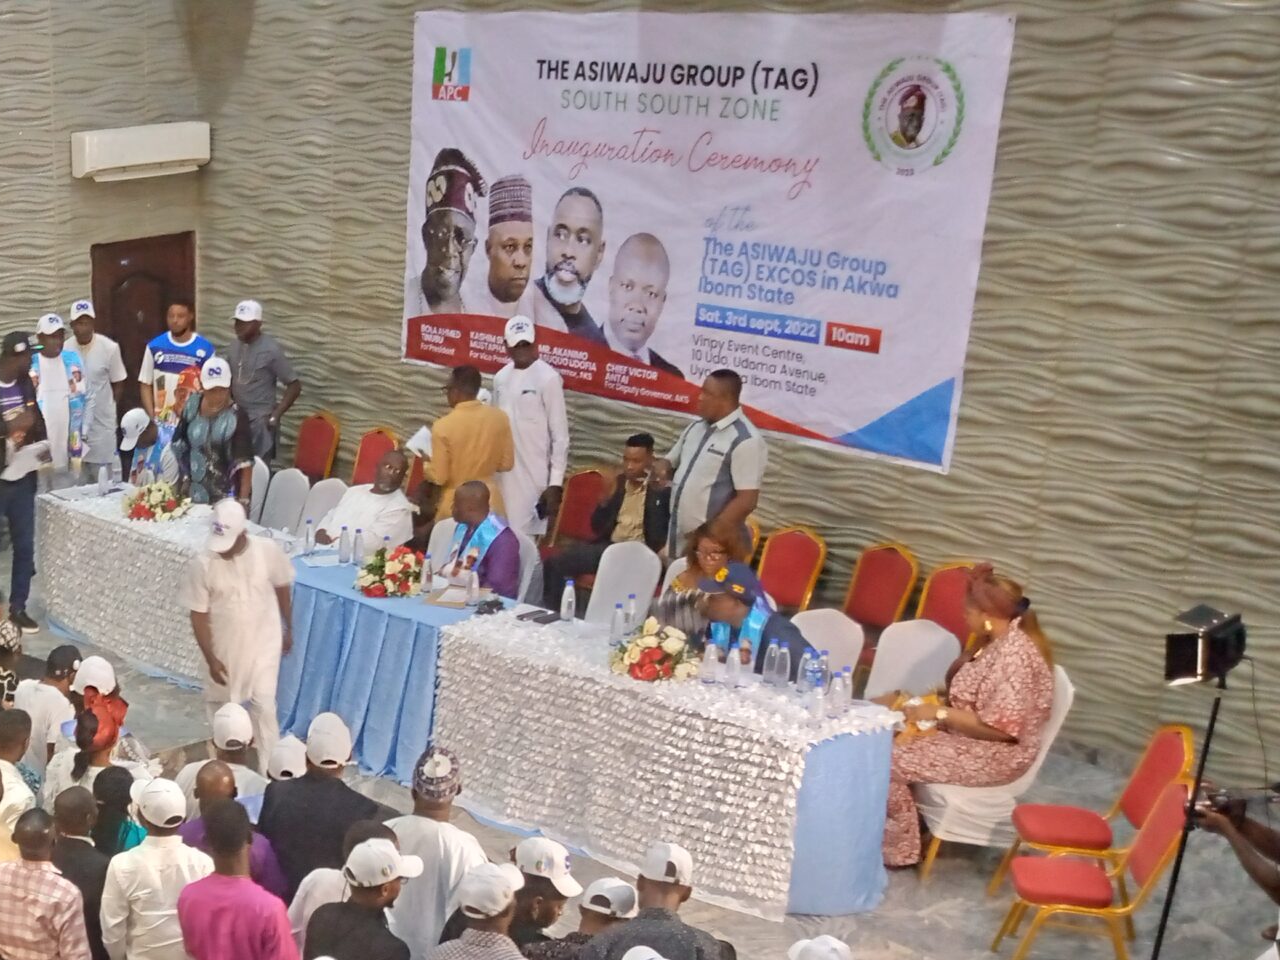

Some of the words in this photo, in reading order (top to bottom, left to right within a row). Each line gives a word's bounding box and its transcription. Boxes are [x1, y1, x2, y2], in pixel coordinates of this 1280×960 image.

[439, 85, 462, 100] APC
[536, 59, 569, 80] THE
[573, 61, 666, 85] ASIWAJU
[670, 63, 745, 88] GROUP
[751, 60, 820, 97] (TAG)
[560, 89, 628, 112] SOUTH
[637, 92, 710, 117] SOUTH
[719, 97, 781, 121] ZONE
[522, 116, 683, 181] Inauguration
[687, 131, 820, 200] Ceremony
[703, 237, 734, 257] The
[738, 241, 822, 267] ASIWAJU
[827, 251, 887, 280] Group
[702, 252, 751, 284] (TAG)
[756, 264, 817, 287] EXCOS
[821, 270, 839, 290] in
[842, 274, 900, 299] Akwa
[698, 276, 743, 299] Ibom
[747, 283, 795, 305] State
[420, 324, 437, 336] BOLA
[698, 308, 722, 324] Sat.
[725, 311, 747, 328] 3rd
[749, 318, 782, 337] sept,
[784, 320, 817, 338] 2022
[831, 326, 869, 347] 10am
[727, 339, 759, 355] Event
[761, 345, 806, 364] Centre,
[605, 372, 629, 385] ANTAI
[606, 363, 628, 376] CHIEF
[628, 368, 658, 381] VICTOR
[691, 348, 702, 361] 10
[733, 356, 777, 375] Udoma
[780, 363, 828, 385] Avenue,
[750, 374, 782, 391] Ibom
[785, 380, 817, 397] State
